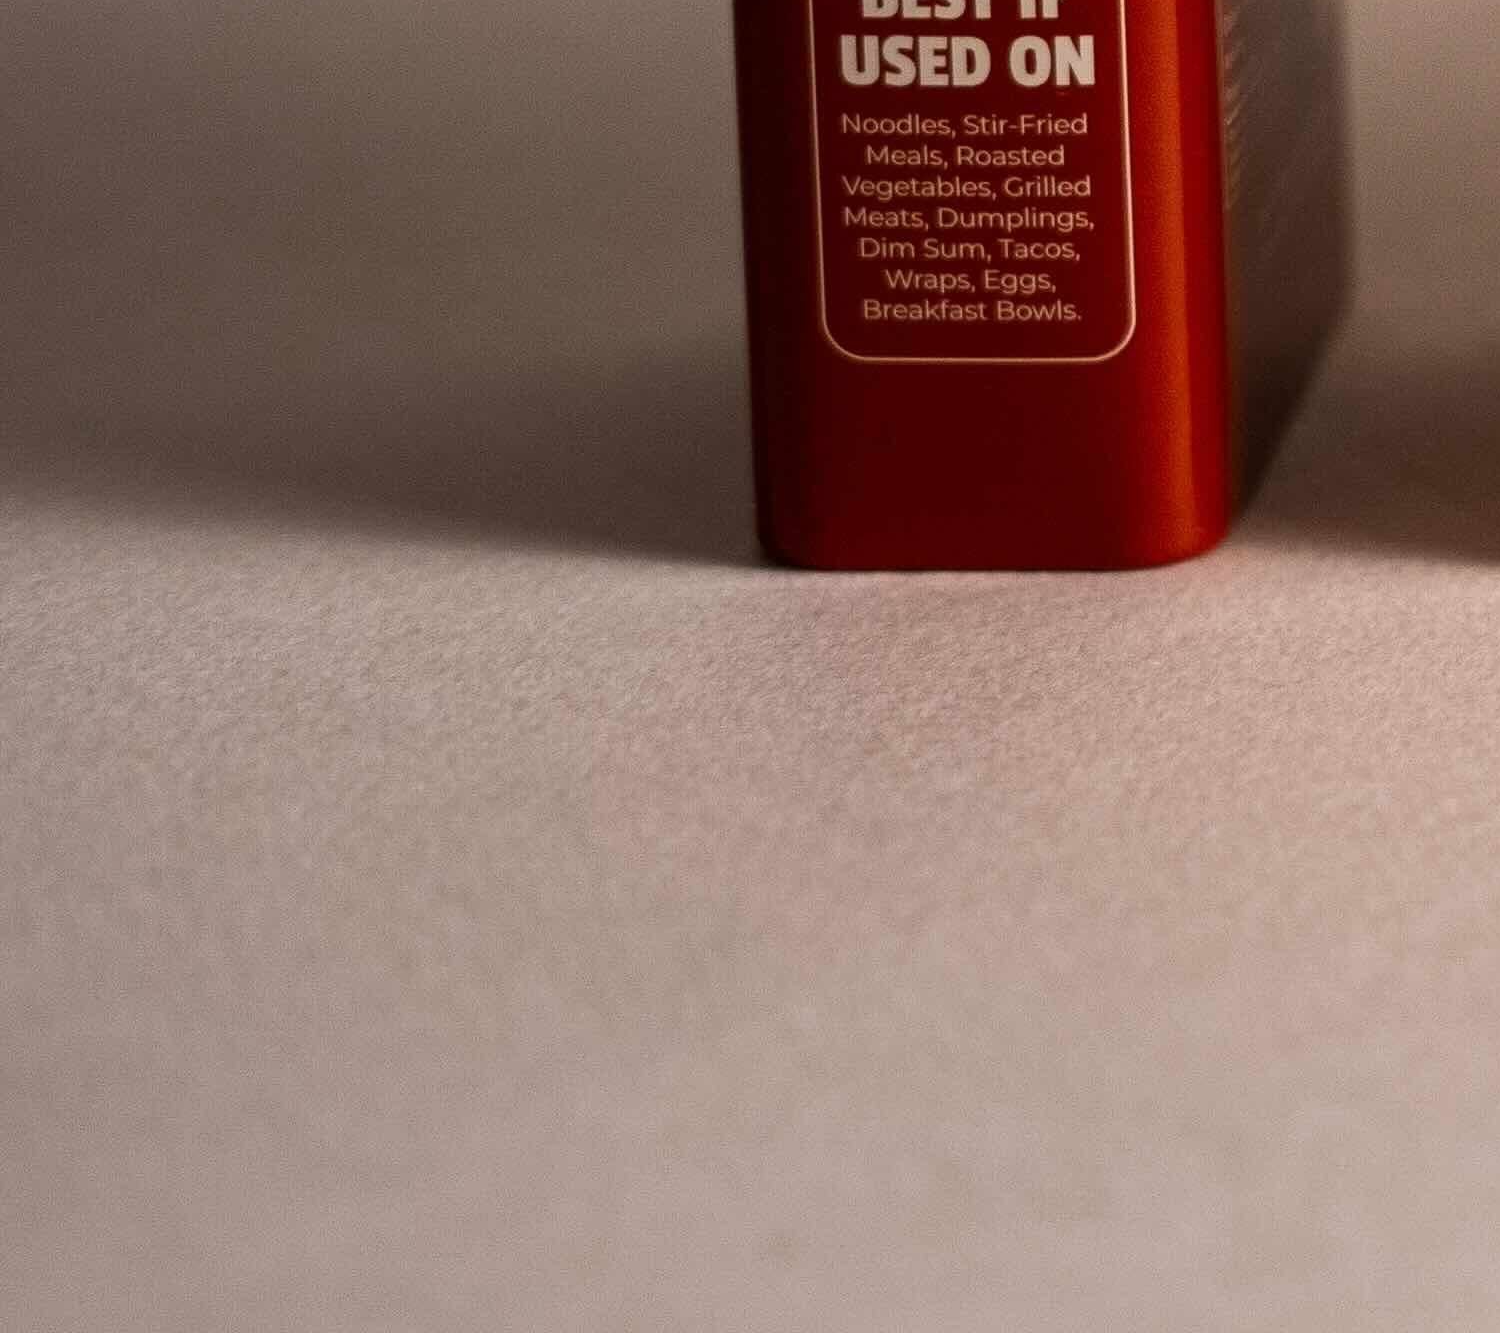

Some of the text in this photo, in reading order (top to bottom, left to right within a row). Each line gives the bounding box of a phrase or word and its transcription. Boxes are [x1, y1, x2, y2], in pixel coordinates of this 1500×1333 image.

[840, 34, 1096, 87] USED ON
[963, 112, 1088, 135] Stir-Fried
[863, 299, 987, 321] Breakfast
